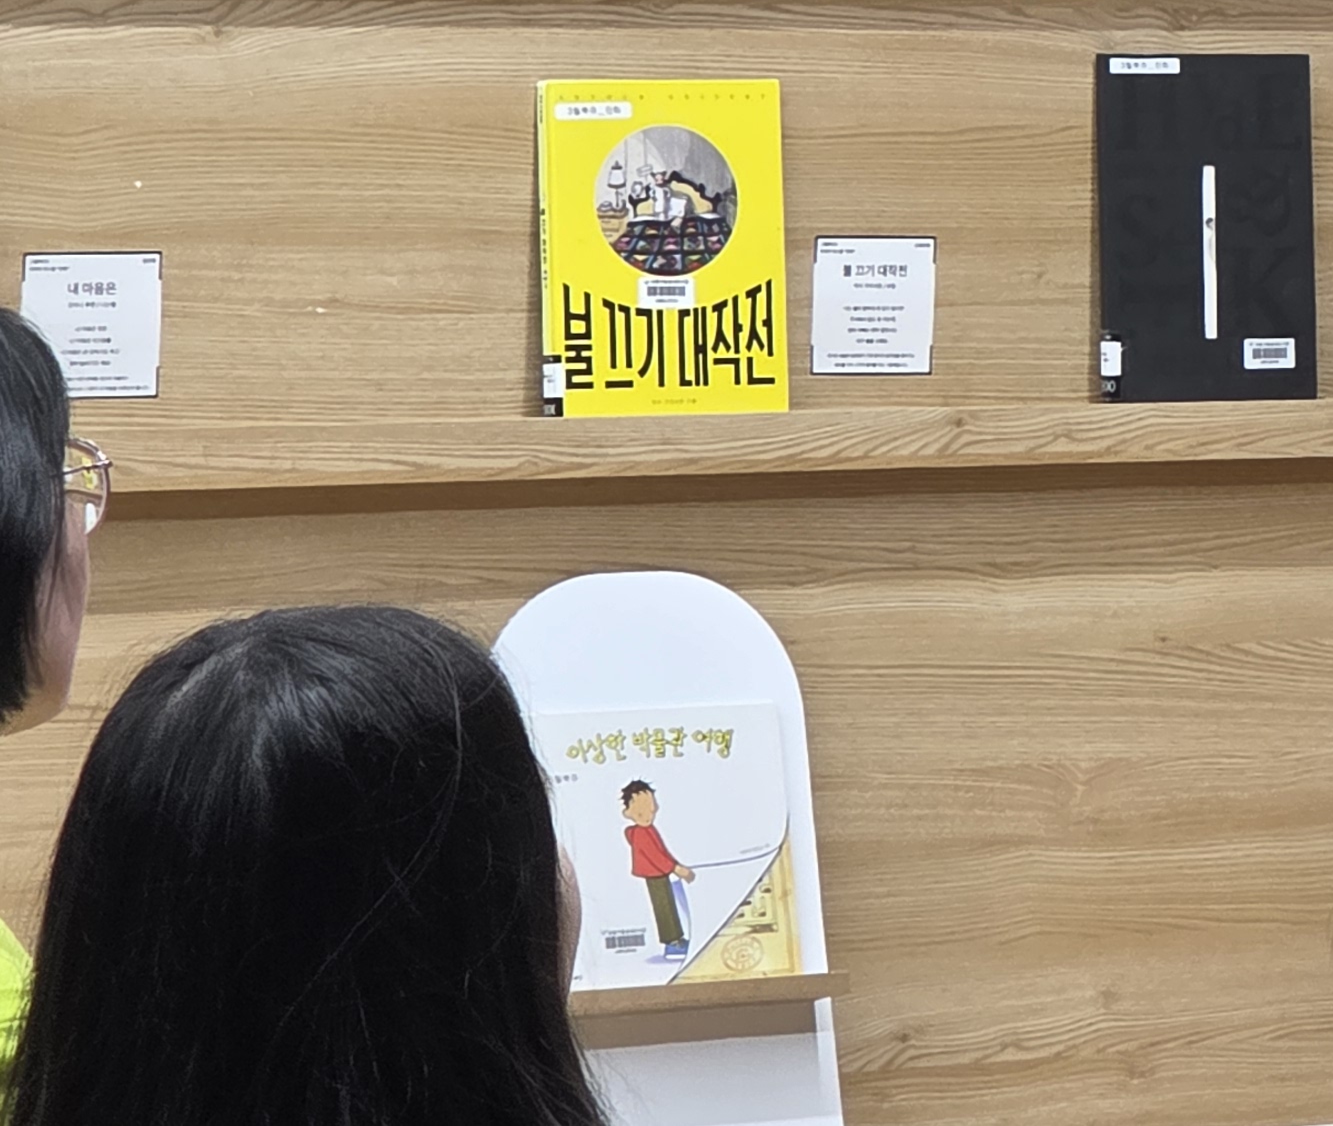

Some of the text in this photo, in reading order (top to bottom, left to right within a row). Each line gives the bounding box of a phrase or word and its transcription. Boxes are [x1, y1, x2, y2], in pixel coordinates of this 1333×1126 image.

[855, 264, 876, 277] 끄기
[877, 264, 908, 277] 대작전
[67, 282, 117, 295] 내 마음은
[563, 278, 776, 390] 불 끄기 대작전
[565, 726, 734, 764] 이상한 박물관 여행
